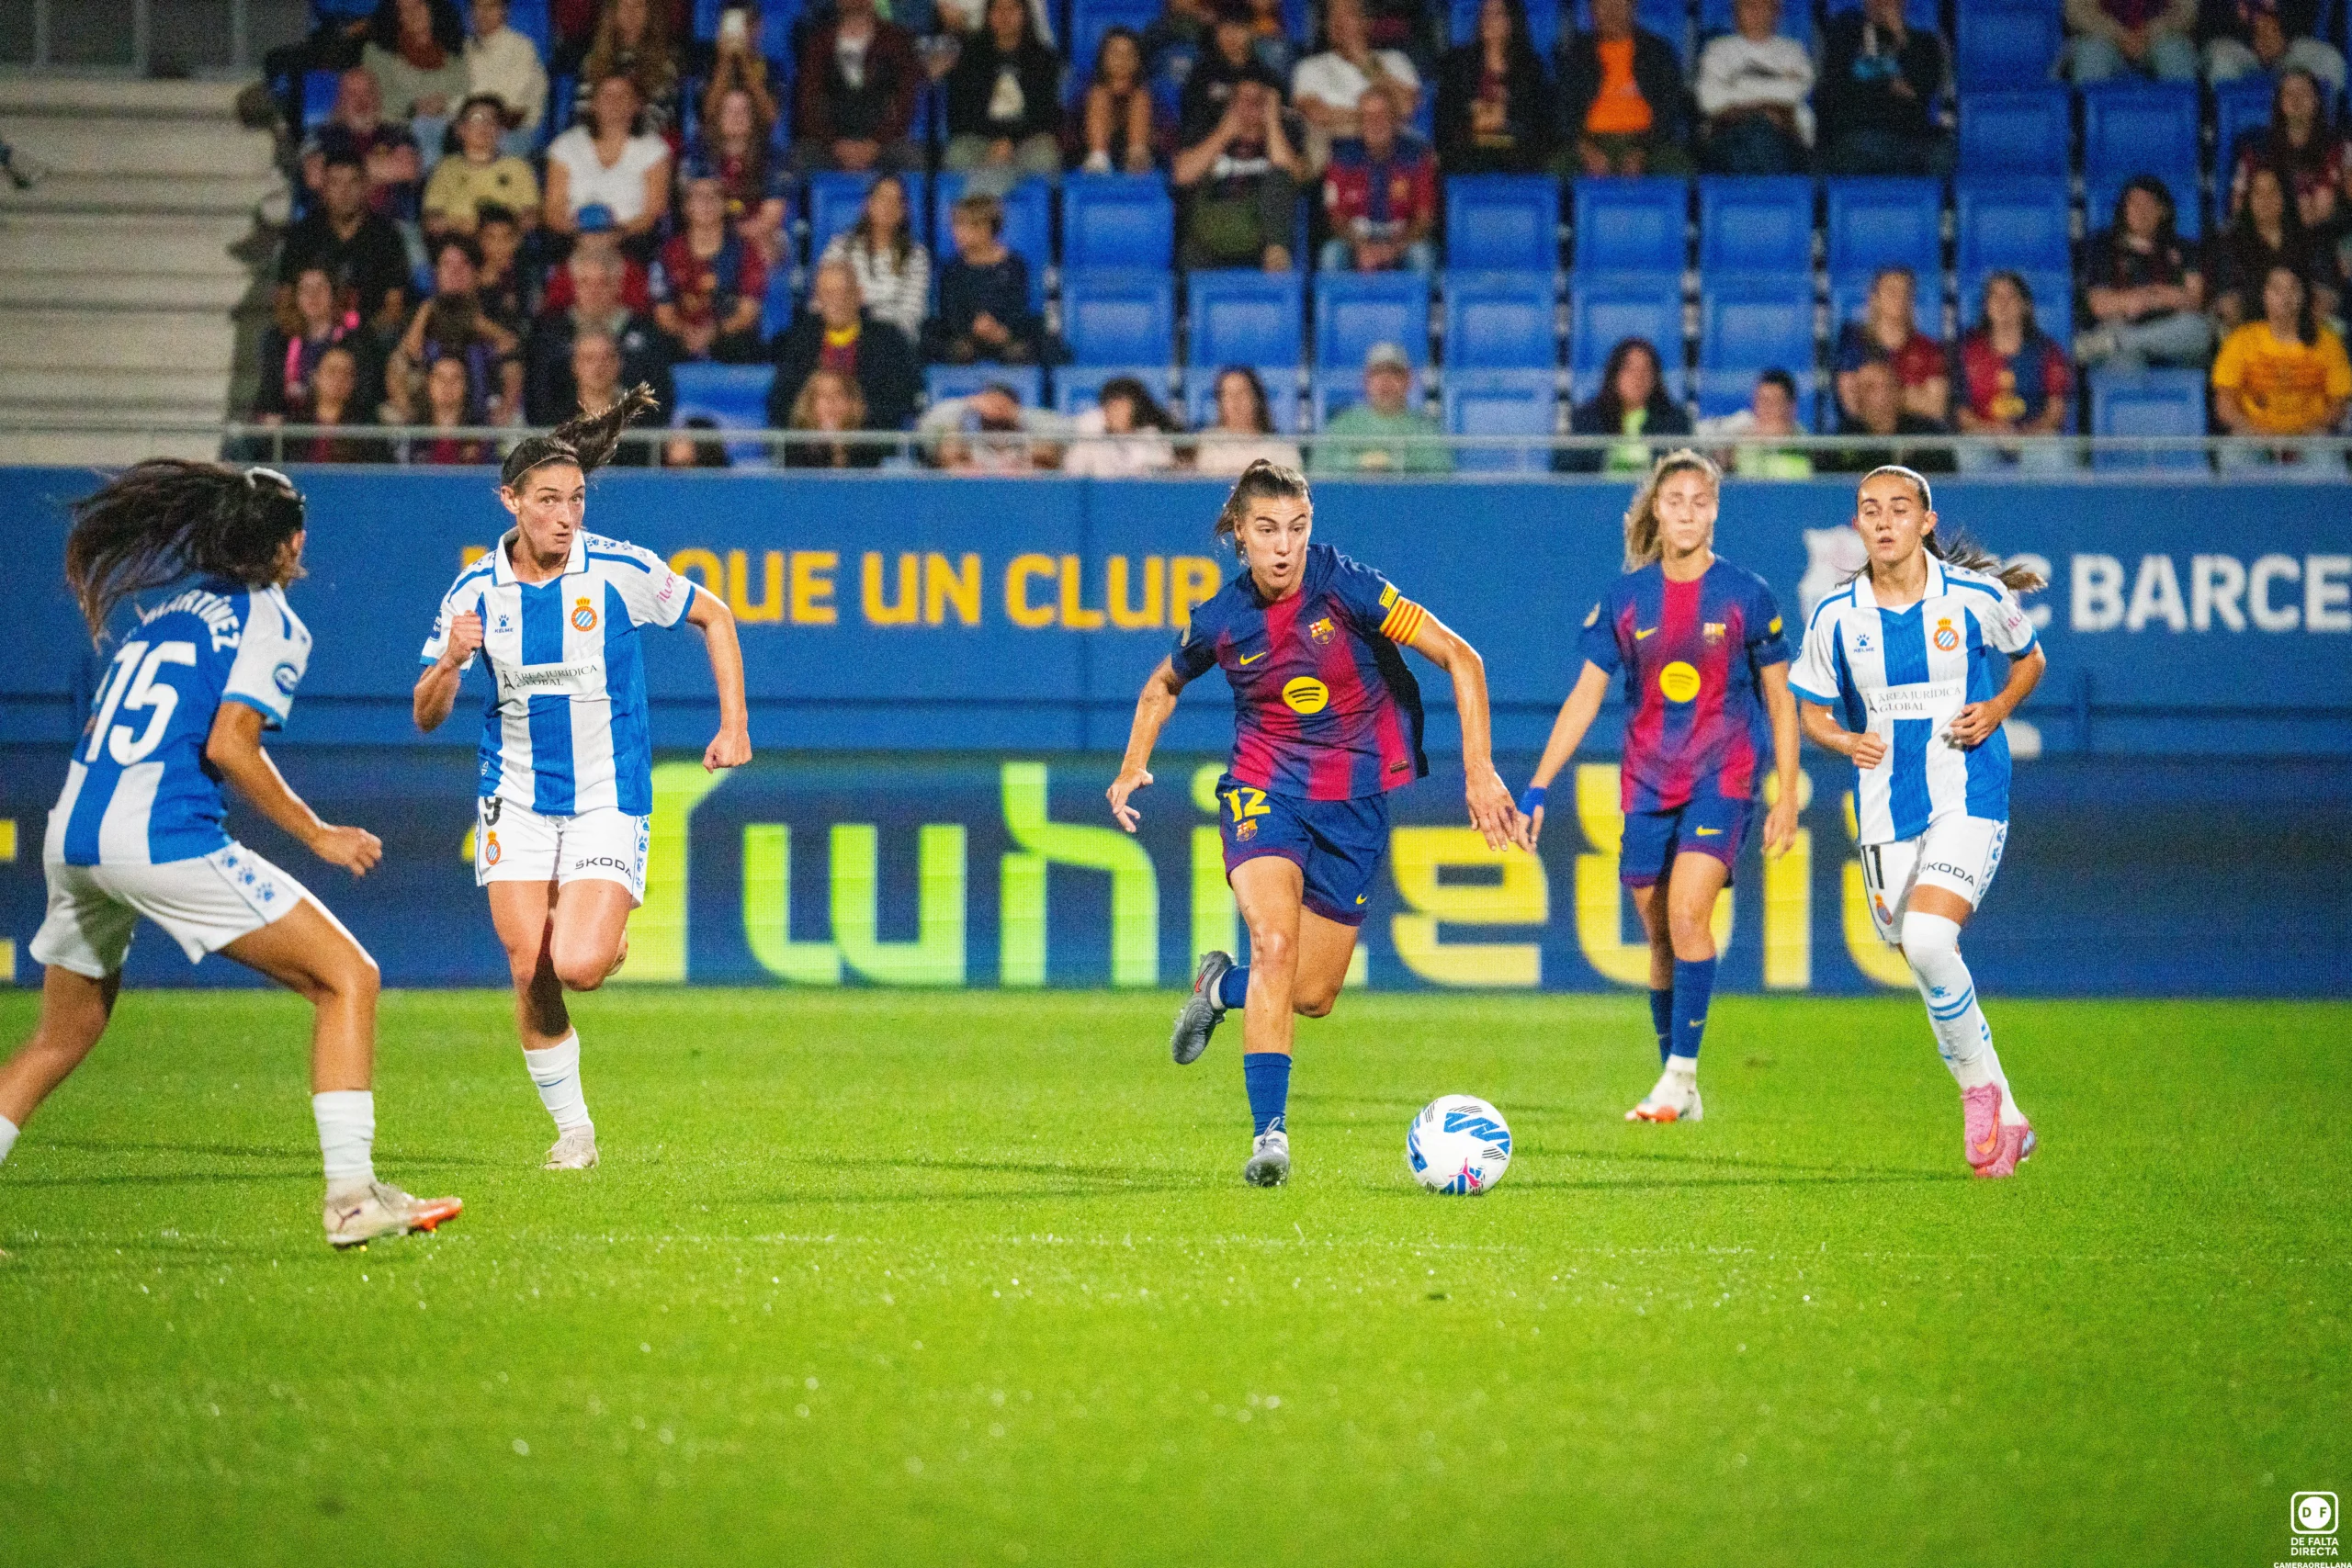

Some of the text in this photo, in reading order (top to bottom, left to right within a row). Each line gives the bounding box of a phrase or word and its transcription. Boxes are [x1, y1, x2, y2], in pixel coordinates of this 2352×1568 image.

[863, 552, 980, 625] UN
[545, 664, 597, 678] JURÍDICA
[85, 640, 197, 767] 15
[1879, 702, 1927, 713] GLOBAL
[1911, 686, 1962, 701] JURÍDICA
[483, 796, 503, 827] 9
[1223, 786, 1272, 822] 12
[1861, 844, 1885, 890] 11
